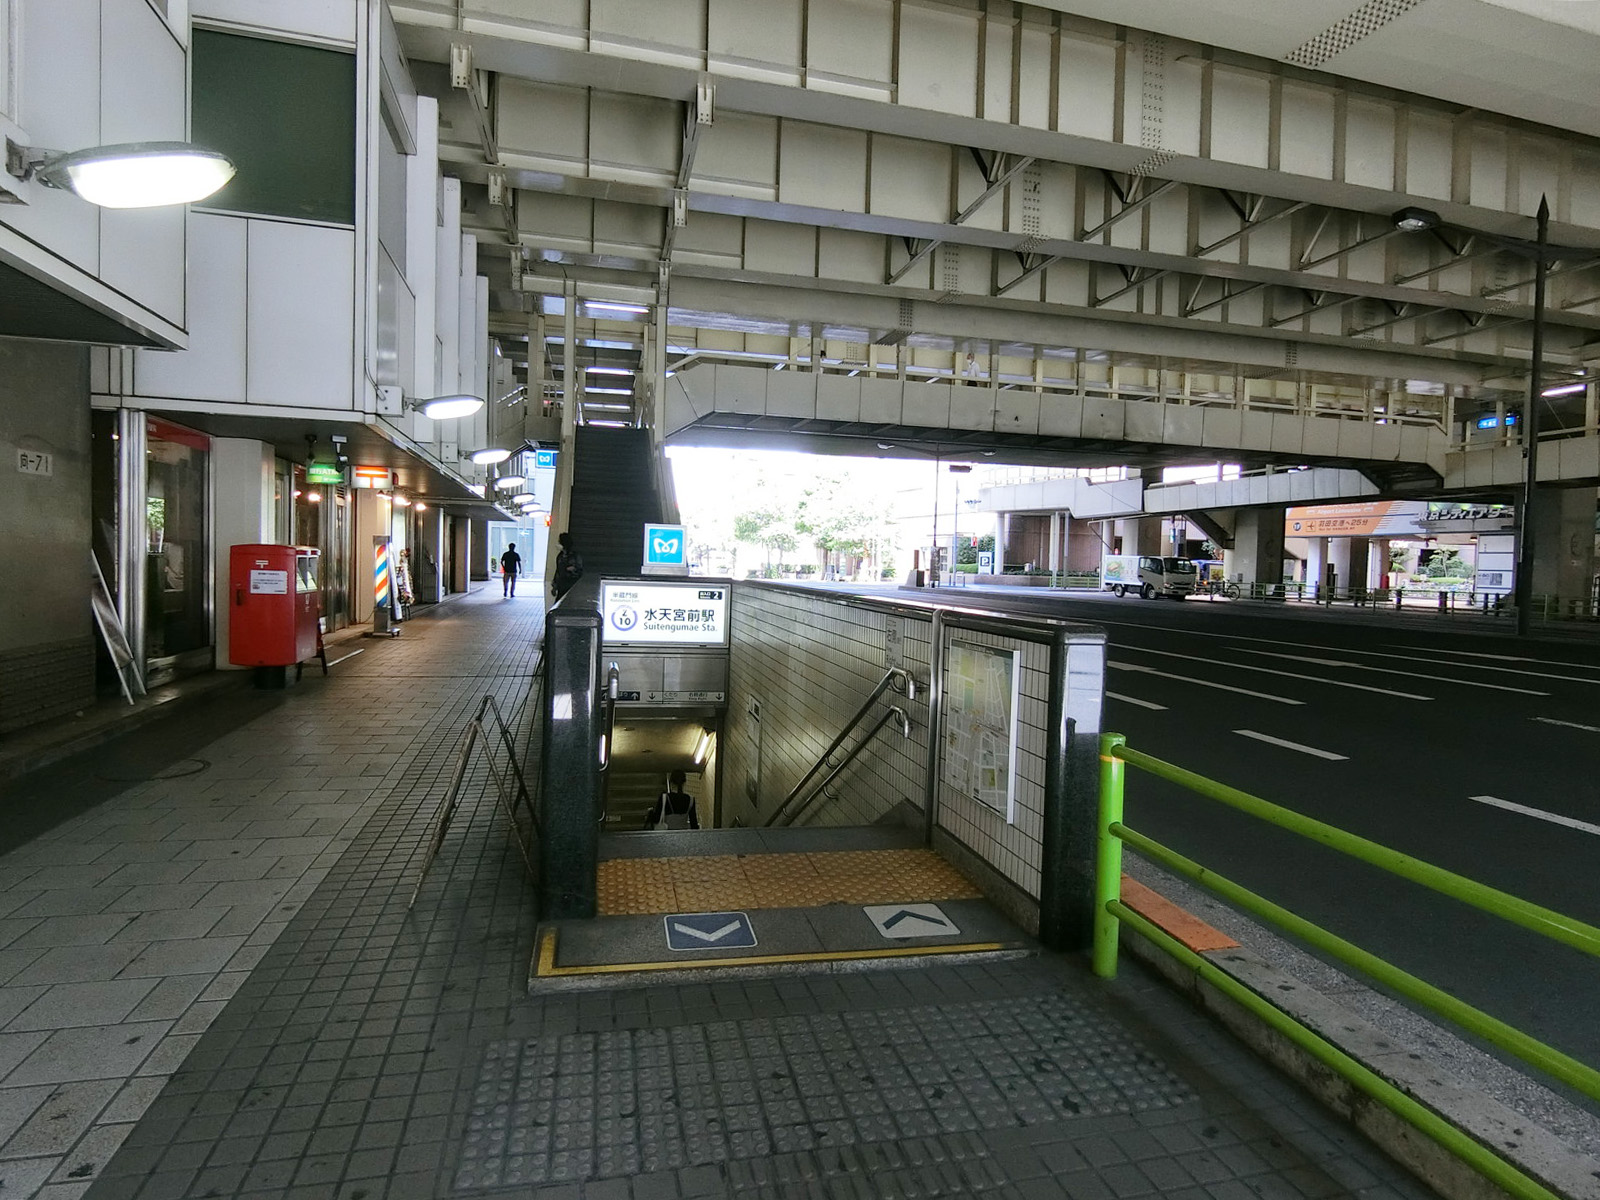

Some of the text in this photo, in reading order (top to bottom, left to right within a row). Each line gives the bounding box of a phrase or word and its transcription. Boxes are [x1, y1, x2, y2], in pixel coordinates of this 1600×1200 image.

[713, 591, 719, 600] 2
[644, 608, 715, 623] 水天宮前駅
[619, 617, 632, 626] 10
[643, 621, 718, 633] Suitengumae Sta.
